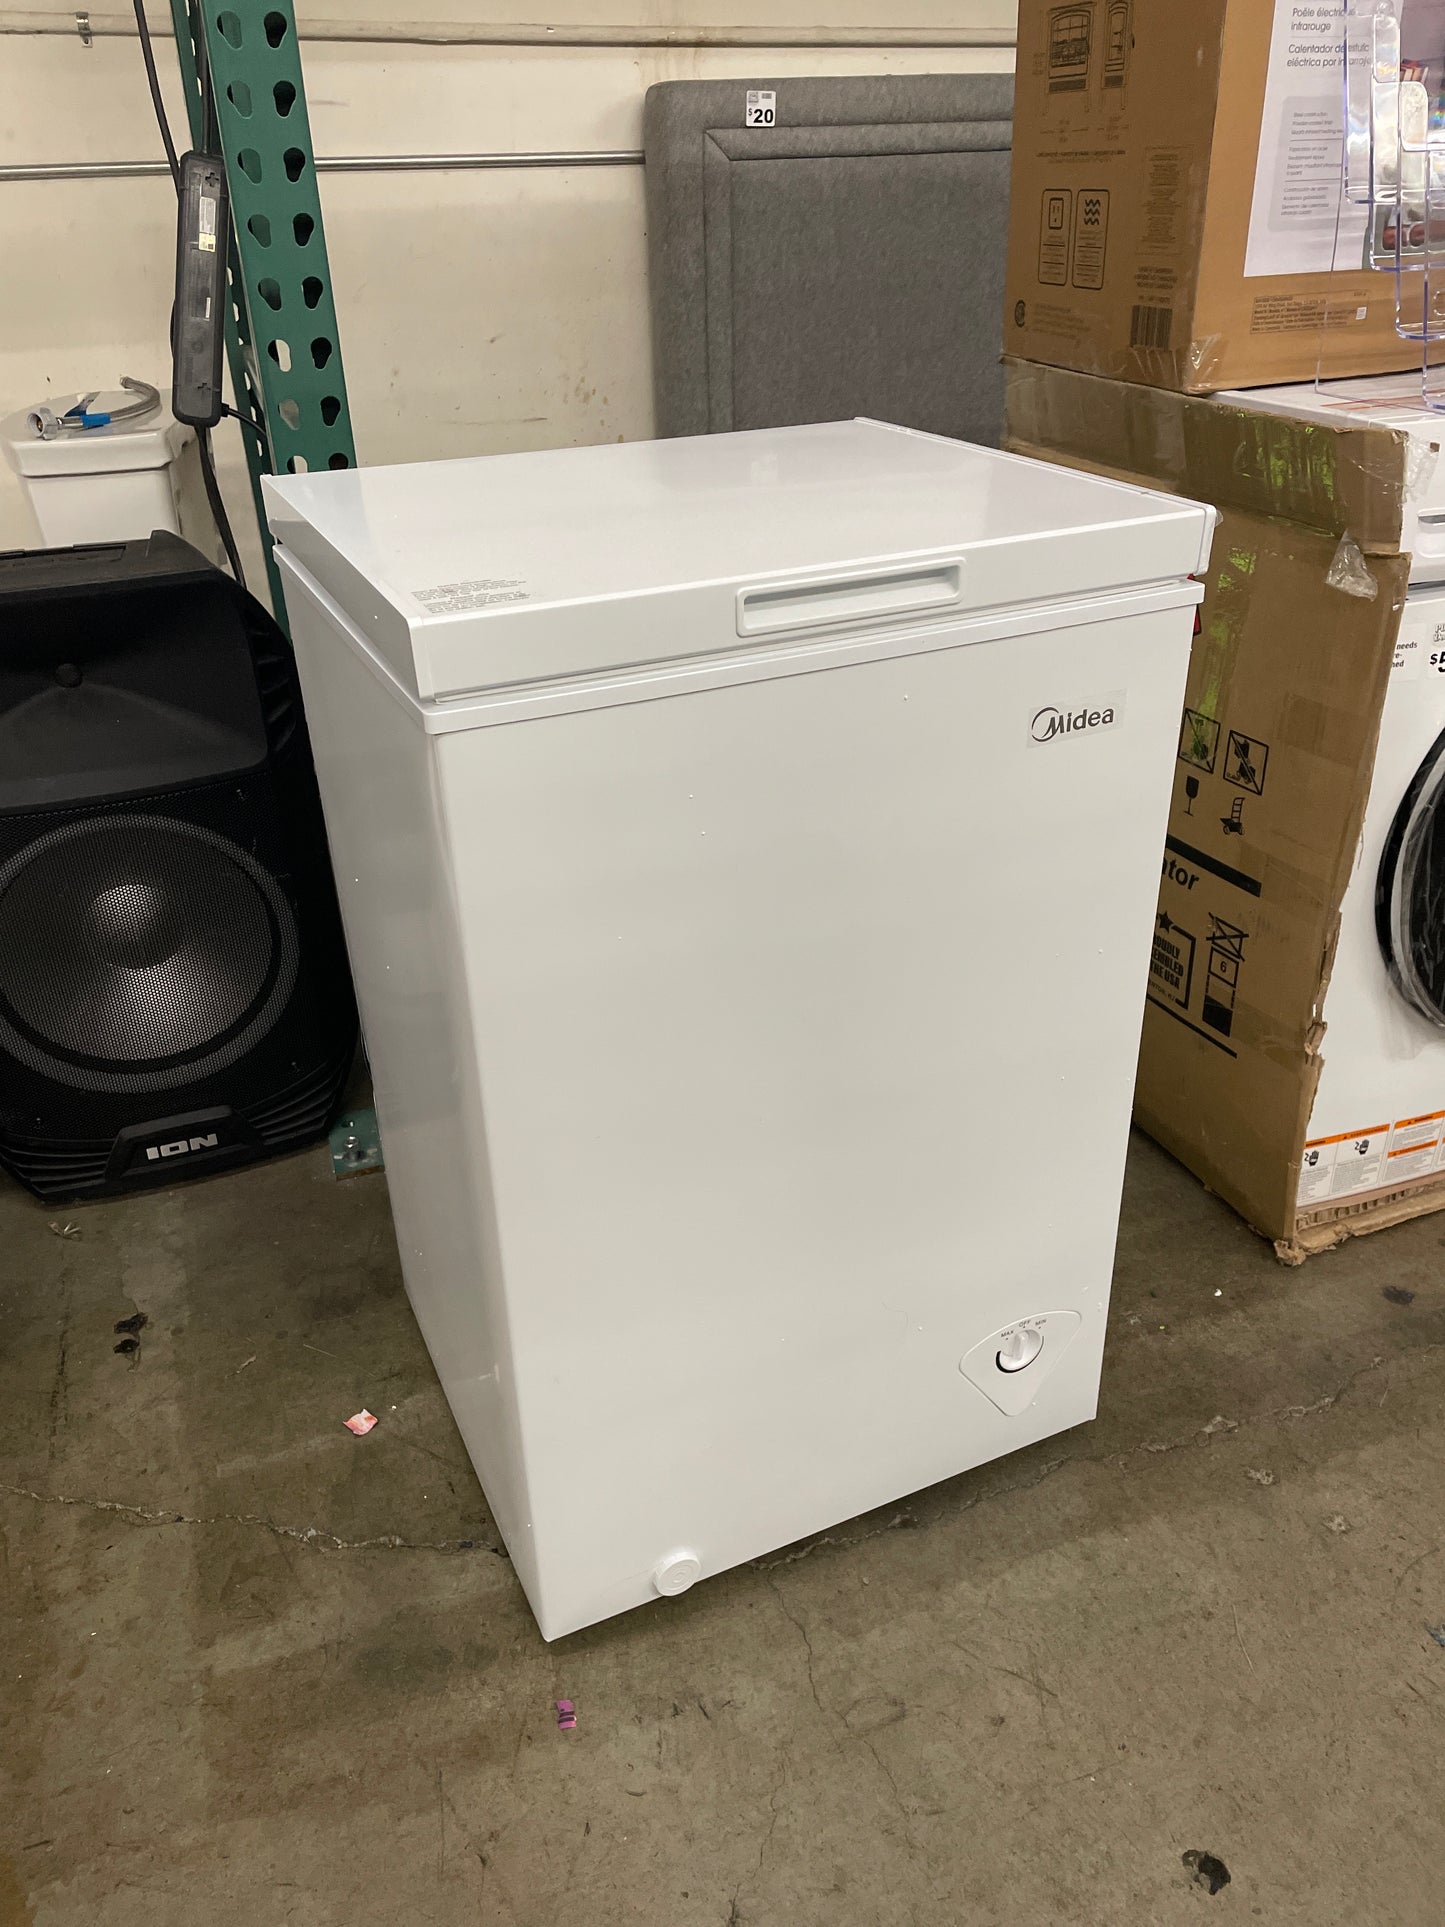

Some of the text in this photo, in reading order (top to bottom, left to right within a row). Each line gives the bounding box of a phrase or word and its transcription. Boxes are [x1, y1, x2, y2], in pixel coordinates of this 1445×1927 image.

[1292, 7, 1315, 17] Poêle
[1290, 21, 1332, 33] infrarouge
[1288, 43, 1333, 54] Calentador
[1286, 58, 1321, 67] eléctrica
[1322, 59, 1337, 68] por
[748, 107, 774, 124] $20
[1397, 641, 1418, 650] needs
[1031, 706, 1115, 743] Midea
[1219, 960, 1227, 973] 6
[146, 1133, 218, 1160] ION
